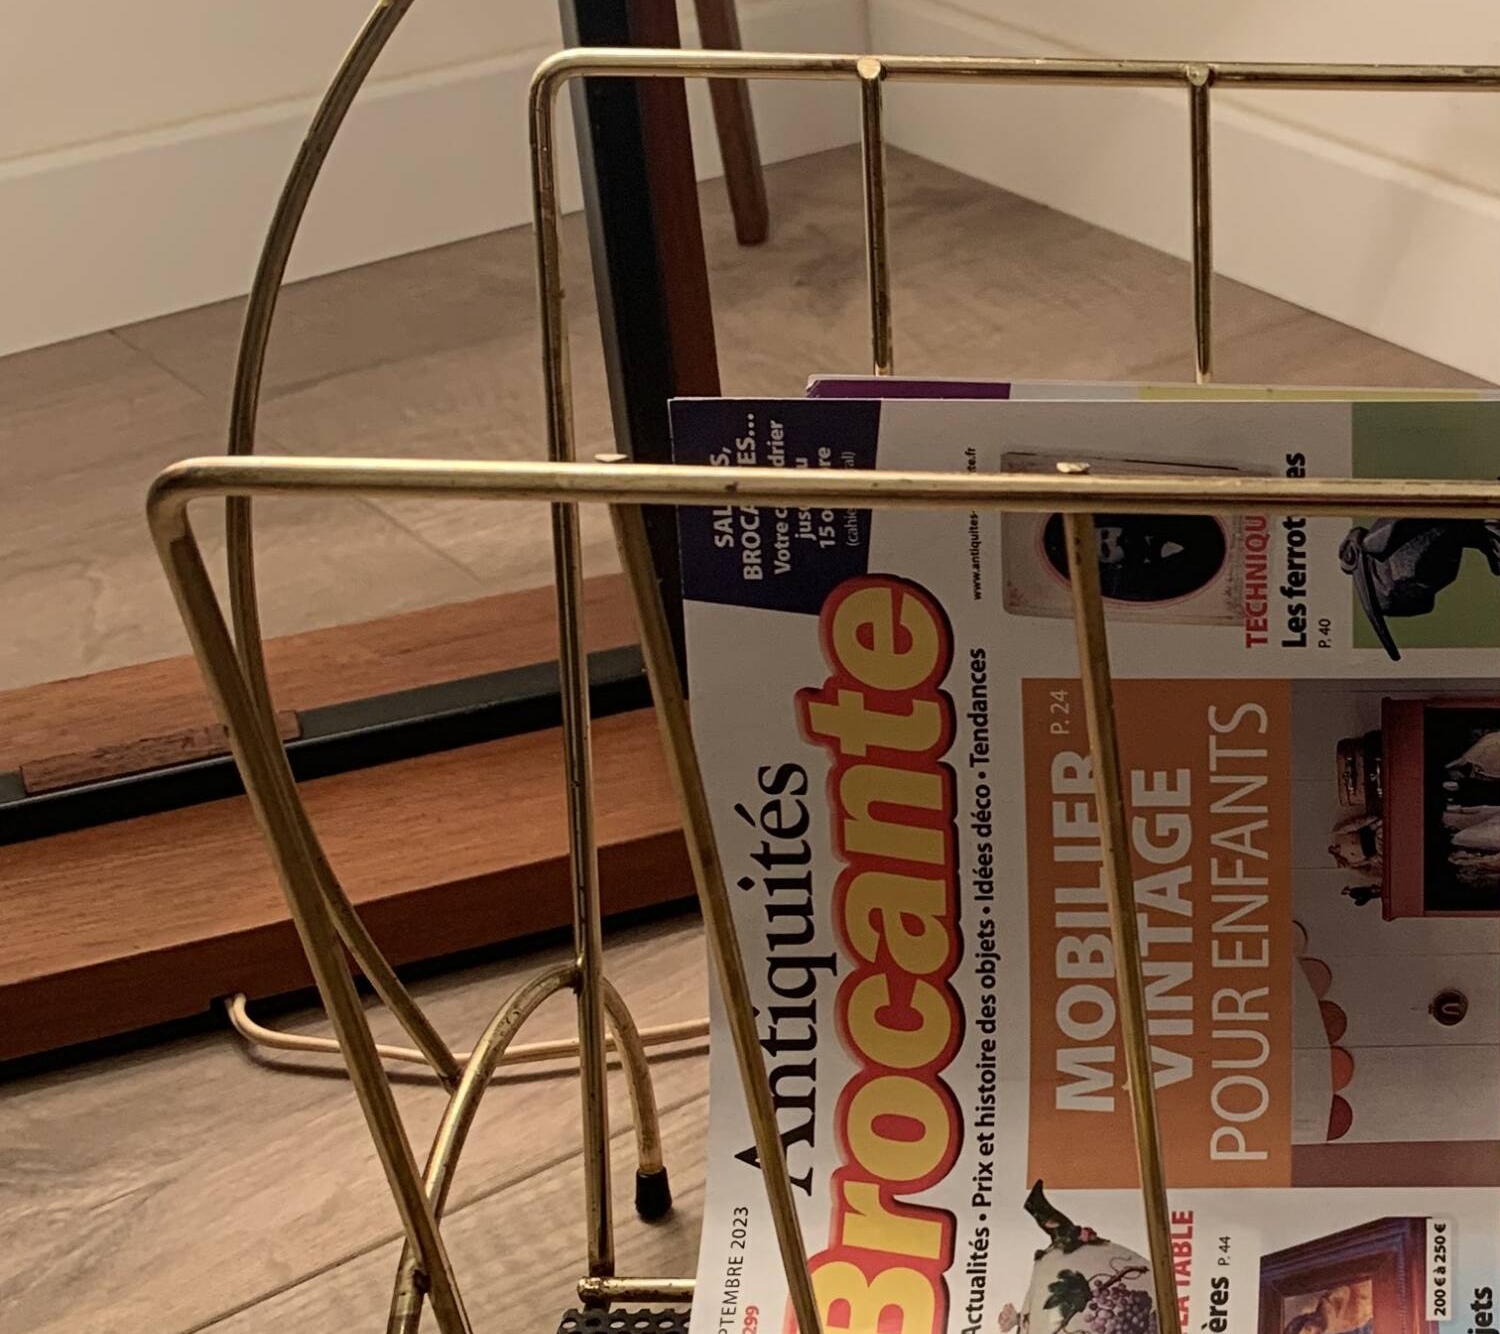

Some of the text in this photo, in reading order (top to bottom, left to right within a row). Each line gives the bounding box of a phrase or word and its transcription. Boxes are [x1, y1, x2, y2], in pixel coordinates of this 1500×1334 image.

[710, 446, 736, 548] SALS,
[735, 413, 764, 580] BROCAES...
[767, 420, 791, 574] Votre cdrier
[820, 525, 836, 549] 15
[1279, 452, 1307, 648] Les ferrotes
[1244, 516, 1270, 648] TECHNIQU
[1318, 619, 1331, 636] 40
[967, 648, 990, 768] Tendances
[1050, 688, 1070, 715] 24
[971, 784, 992, 837] déco
[973, 843, 995, 901] Idées
[975, 919, 1001, 989] objets
[1050, 750, 1116, 1113] MOBILIER
[1130, 767, 1195, 1090] VINTAGE
[1208, 702, 1271, 1161] POUR ENFANTS
[734, 763, 838, 1196] Antiquités
[975, 994, 996, 1034] des
[974, 1039, 996, 1127] histoire
[976, 1132, 994, 1156] et
[972, 1161, 994, 1207] Prix
[729, 1206, 749, 1249] 2023
[1219, 1236, 1231, 1253] 44
[1434, 1236, 1446, 1263] 250
[1433, 1266, 1446, 1275] à
[1434, 1289, 1446, 1316] 200
